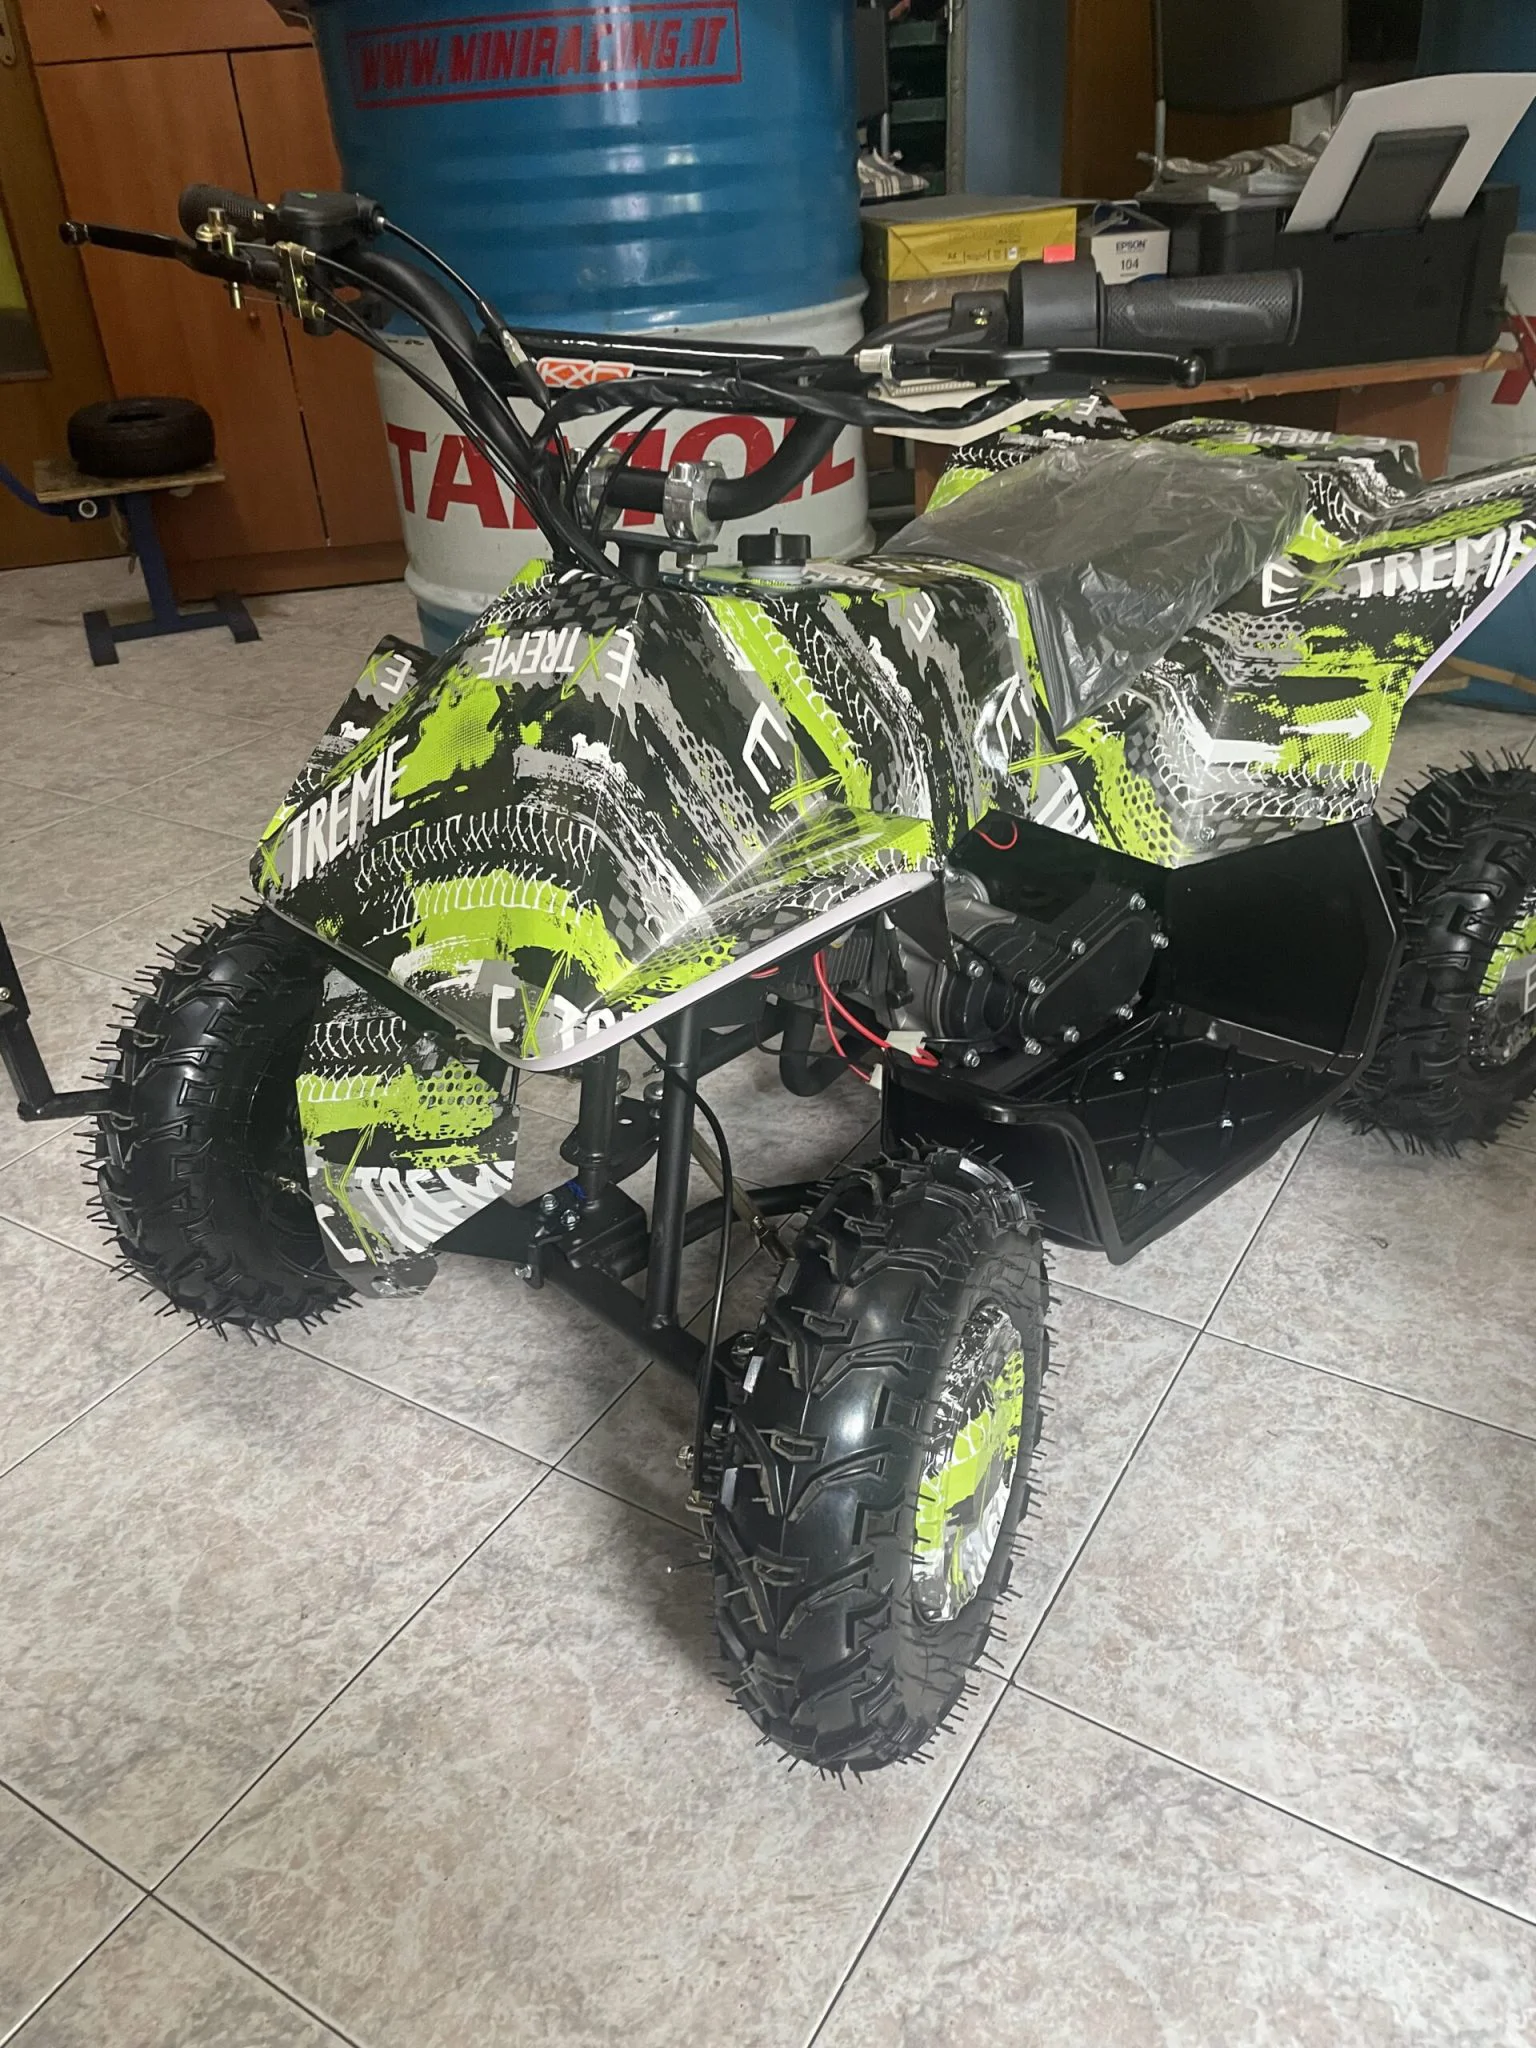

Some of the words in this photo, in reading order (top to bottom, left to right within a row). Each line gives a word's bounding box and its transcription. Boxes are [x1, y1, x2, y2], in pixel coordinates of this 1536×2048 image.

[361, 17, 727, 92] WWW.MINIRACING.IT
[1116, 239, 1146, 251] EPSON
[1121, 257, 1139, 270] 104
